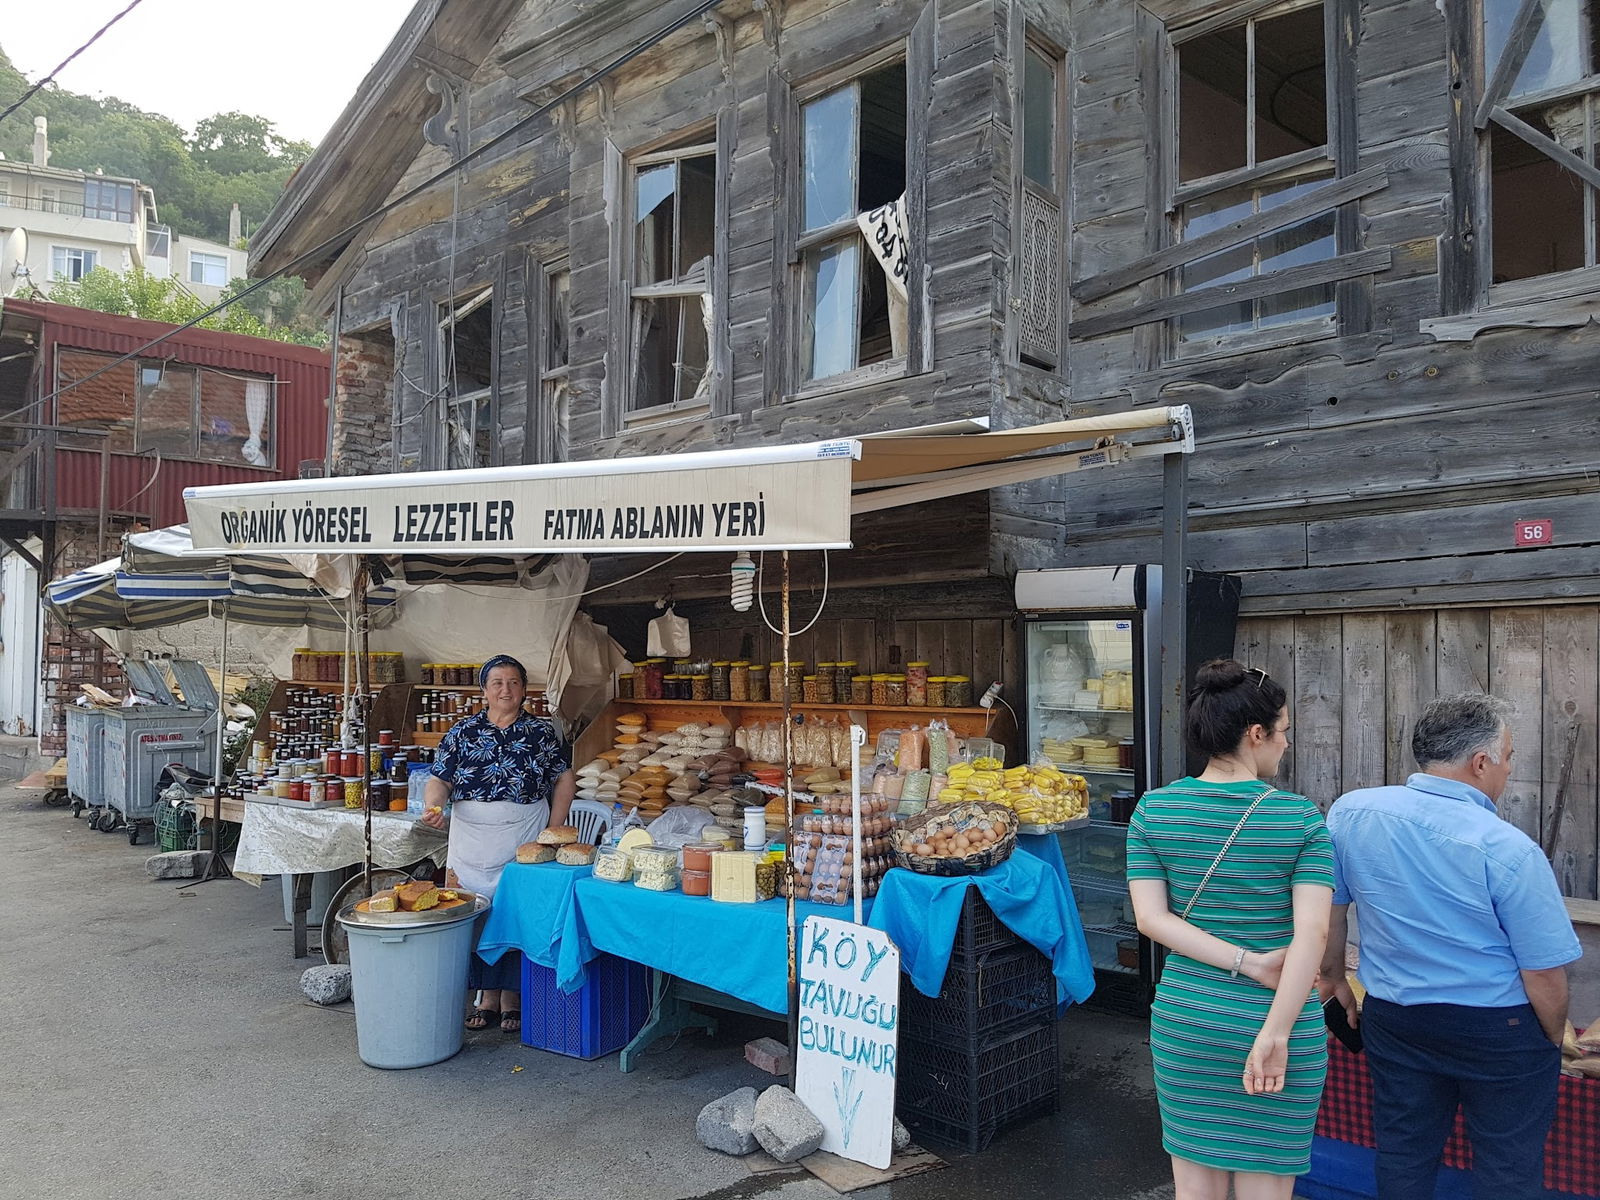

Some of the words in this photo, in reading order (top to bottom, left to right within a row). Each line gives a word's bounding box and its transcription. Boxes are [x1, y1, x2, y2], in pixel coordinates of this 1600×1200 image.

[221, 501, 287, 544] ORGANİK
[292, 501, 371, 543] YÖRESEL
[393, 500, 514, 542] LEZZETLER
[544, 507, 604, 540] FATMA
[611, 504, 704, 539] ABLANIN
[712, 492, 765, 537] YERİ
[1524, 525, 1543, 539] 56
[808, 922, 889, 982] KÖY
[800, 977, 896, 1031] TAVUĞU
[800, 1015, 895, 1079] BULUNUR
